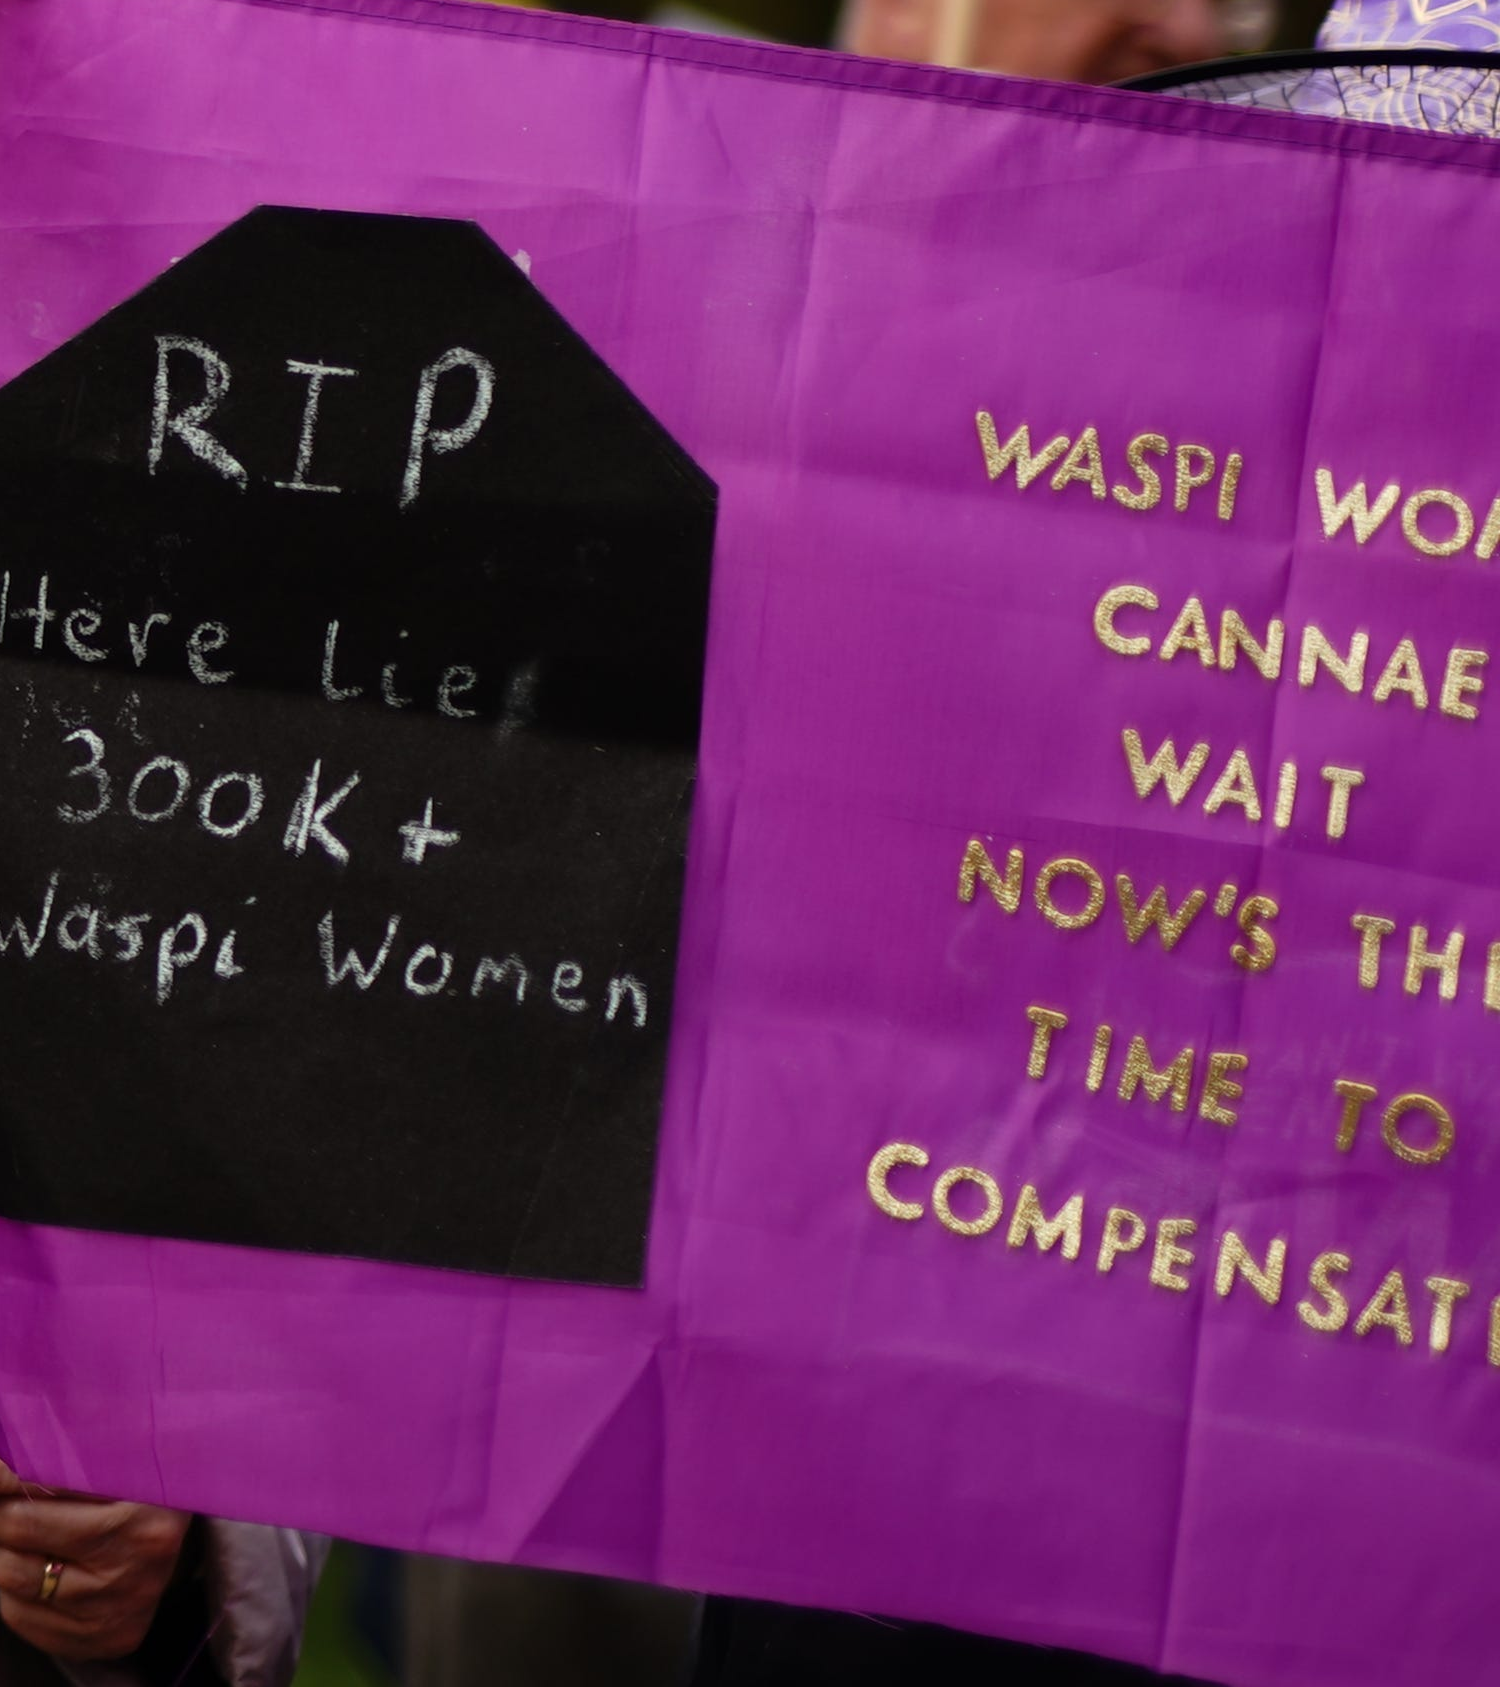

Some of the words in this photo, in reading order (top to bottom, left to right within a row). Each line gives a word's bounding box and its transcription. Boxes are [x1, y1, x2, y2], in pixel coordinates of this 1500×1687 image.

[148, 335, 495, 507] RIP
[976, 411, 1242, 521] WASPI
[1093, 584, 1488, 719] CANNAE
[1122, 728, 1364, 839] WAIT
[318, 910, 648, 1028] Women
[957, 839, 1279, 972] NOW'S
[1027, 1005, 1248, 1125] TIME
[1333, 1079, 1455, 1164] TO
[866, 1142, 1500, 1366] COMPENSAT
